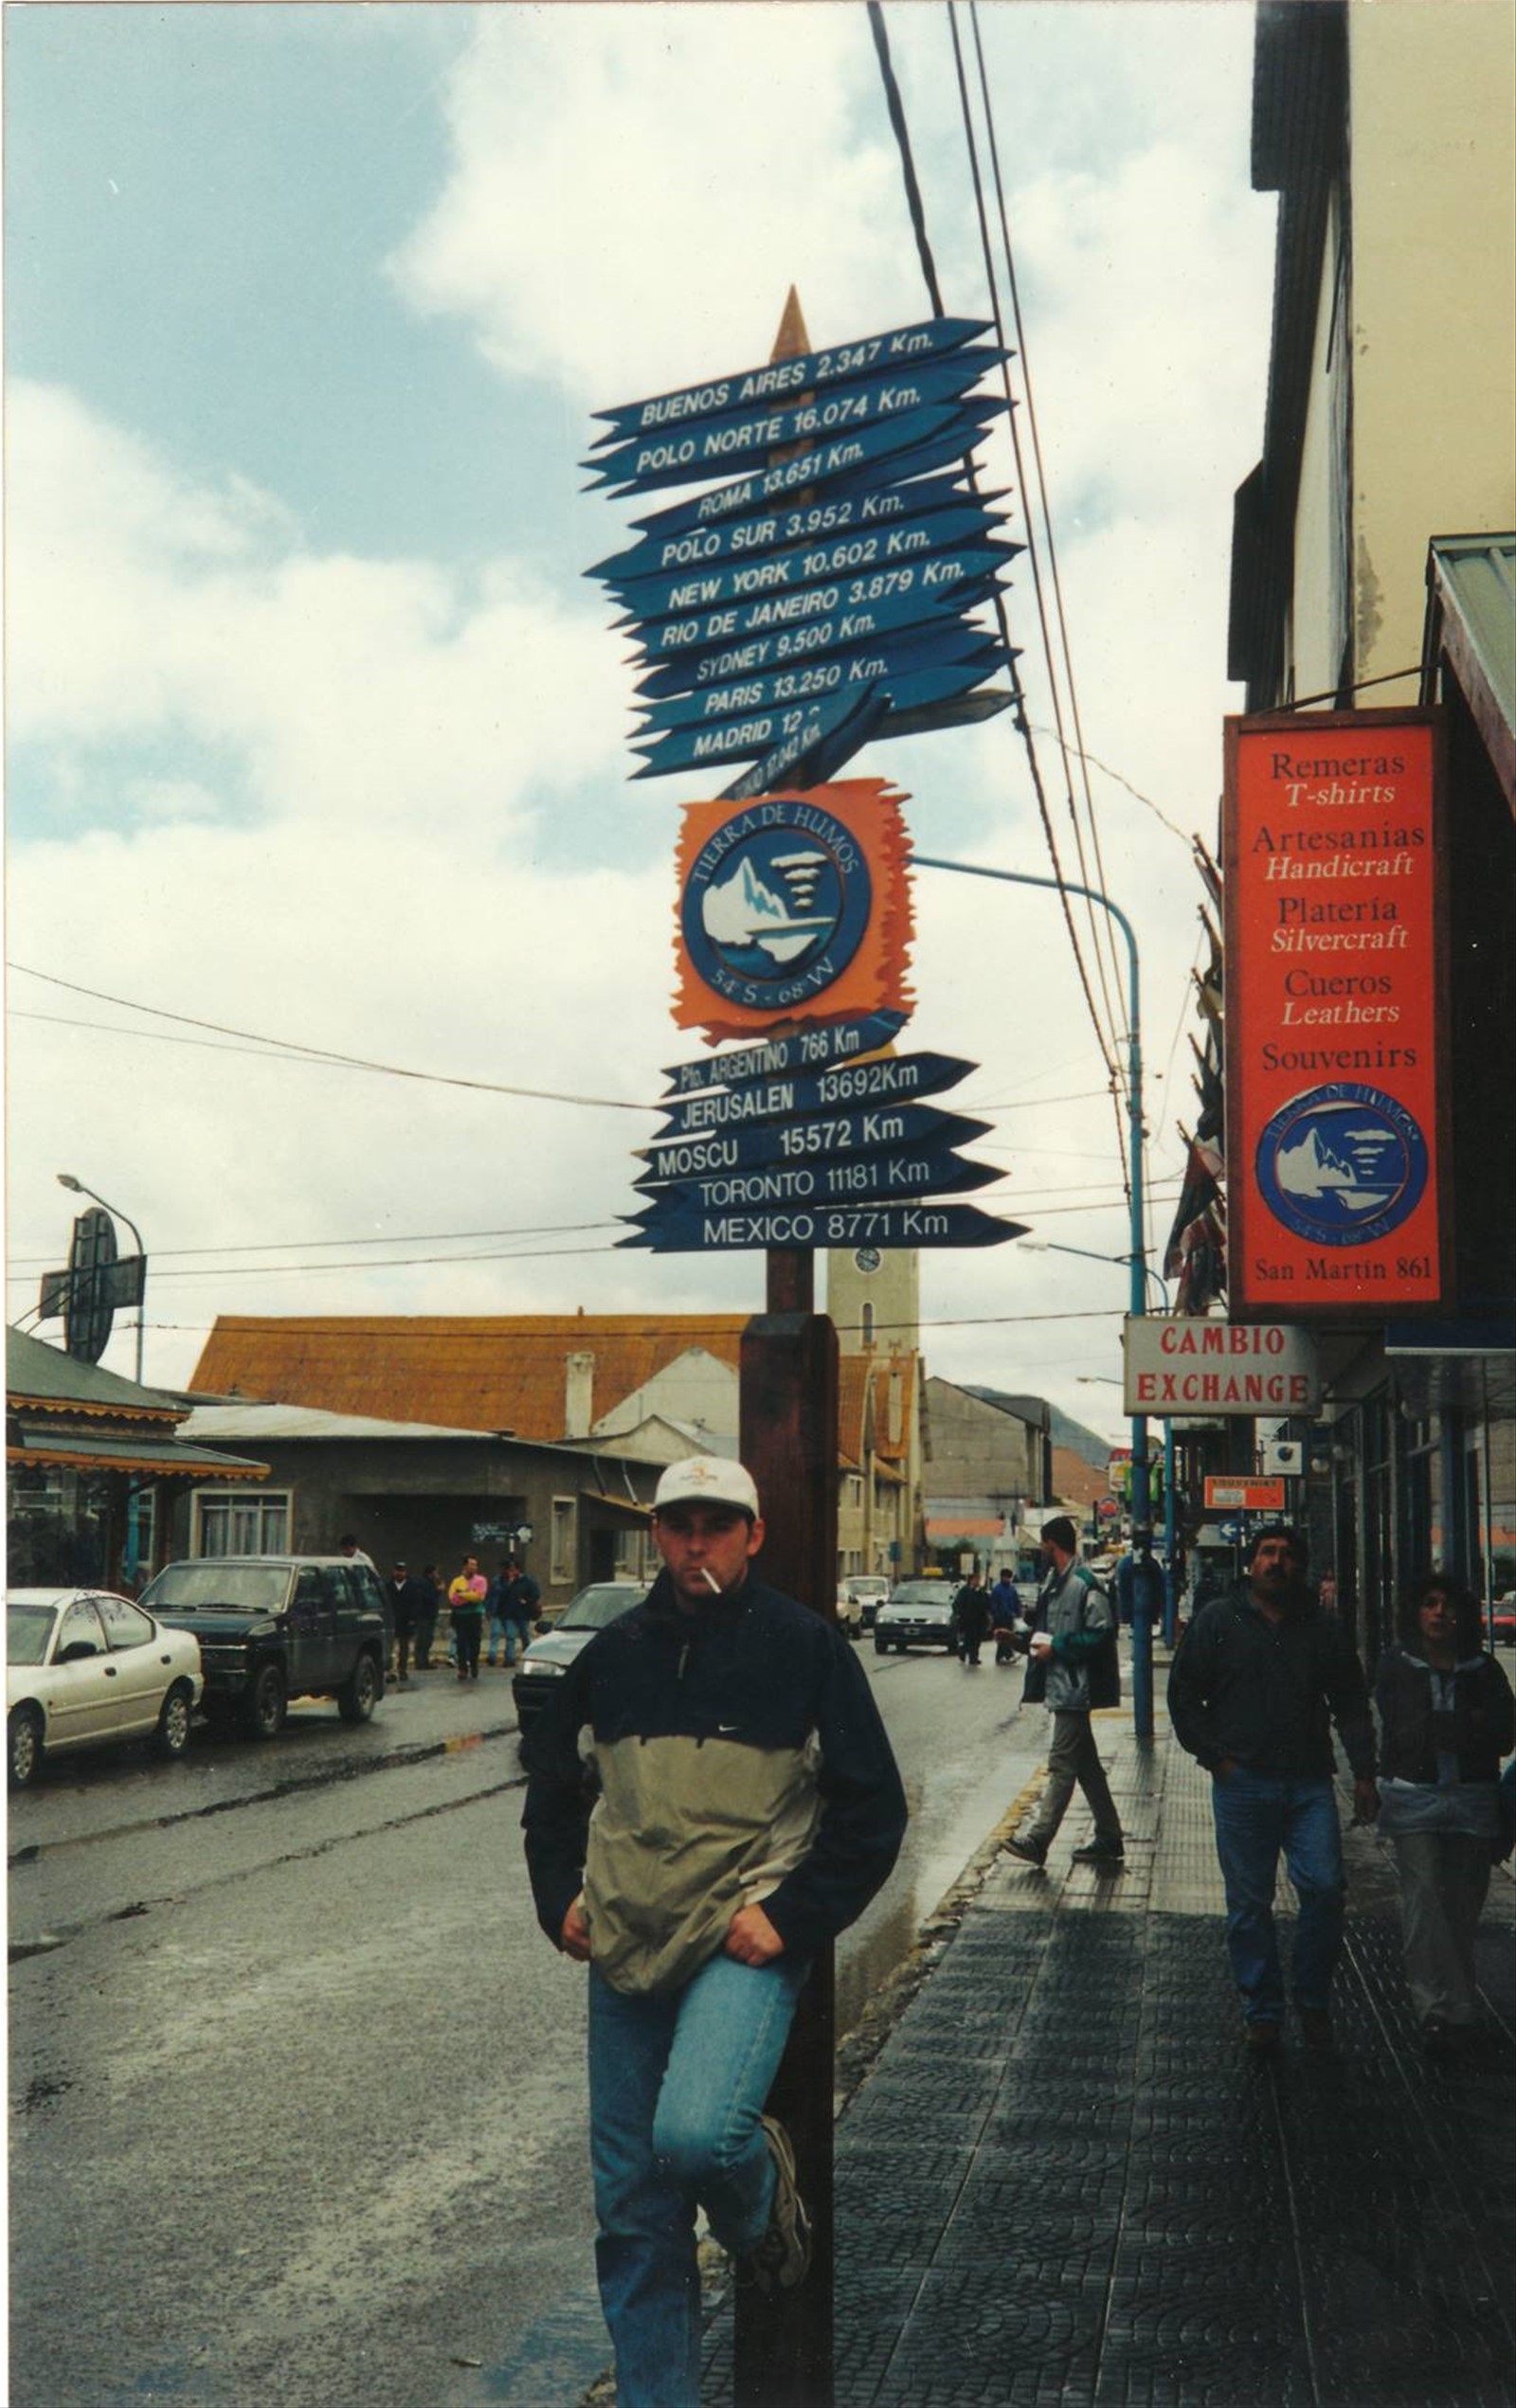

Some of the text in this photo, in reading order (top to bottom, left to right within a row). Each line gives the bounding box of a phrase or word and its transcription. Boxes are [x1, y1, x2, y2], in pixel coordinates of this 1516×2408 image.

[641, 332, 934, 426] BUENOS AIRES 2.347 Km.
[637, 386, 921, 474] POLO NORTE 16.074 Km.
[697, 442, 864, 519] ROMA 13.651 Km.
[661, 490, 905, 566] POLO SUR 3.952 Km.
[669, 530, 930, 609] NEW YORK 10.602 Km.
[661, 561, 966, 648] RIO DE JANEIRO 3.879 Km.
[696, 615, 876, 681] SYDNEY 9.500 Km.
[704, 657, 889, 714] PARIS 13.250 Km.
[693, 719, 772, 757] MADRID
[1272, 752, 1406, 780] Remeras
[1284, 781, 1396, 807] T-shirts
[694, 803, 858, 882] TIERRA DE HUMOS
[1264, 851, 1415, 881] Handicraft
[1271, 924, 1409, 954] Silvercraft
[743, 984, 758, 1004] S
[807, 957, 836, 986] W
[1284, 969, 1393, 997] Cueros
[1281, 1000, 1400, 1026] Leathers
[710, 1042, 788, 1084] ARGENTINO
[800, 1031, 829, 1064] 766
[834, 1026, 860, 1054] Km
[1261, 1041, 1417, 1071] Souvenirs
[680, 1084, 794, 1130] JERUSALEN
[659, 1114, 905, 1177] MOSCU 15572 Km
[700, 1159, 930, 1207] TORONTO 11181 Km
[703, 1209, 948, 1244] MEXICO 8771 Km
[1254, 1258, 1294, 1281] San
[1396, 1256, 1432, 1279] 861
[1160, 1325, 1285, 1355] CAMBIO
[1138, 1374, 1309, 1403] EXCHANGE
